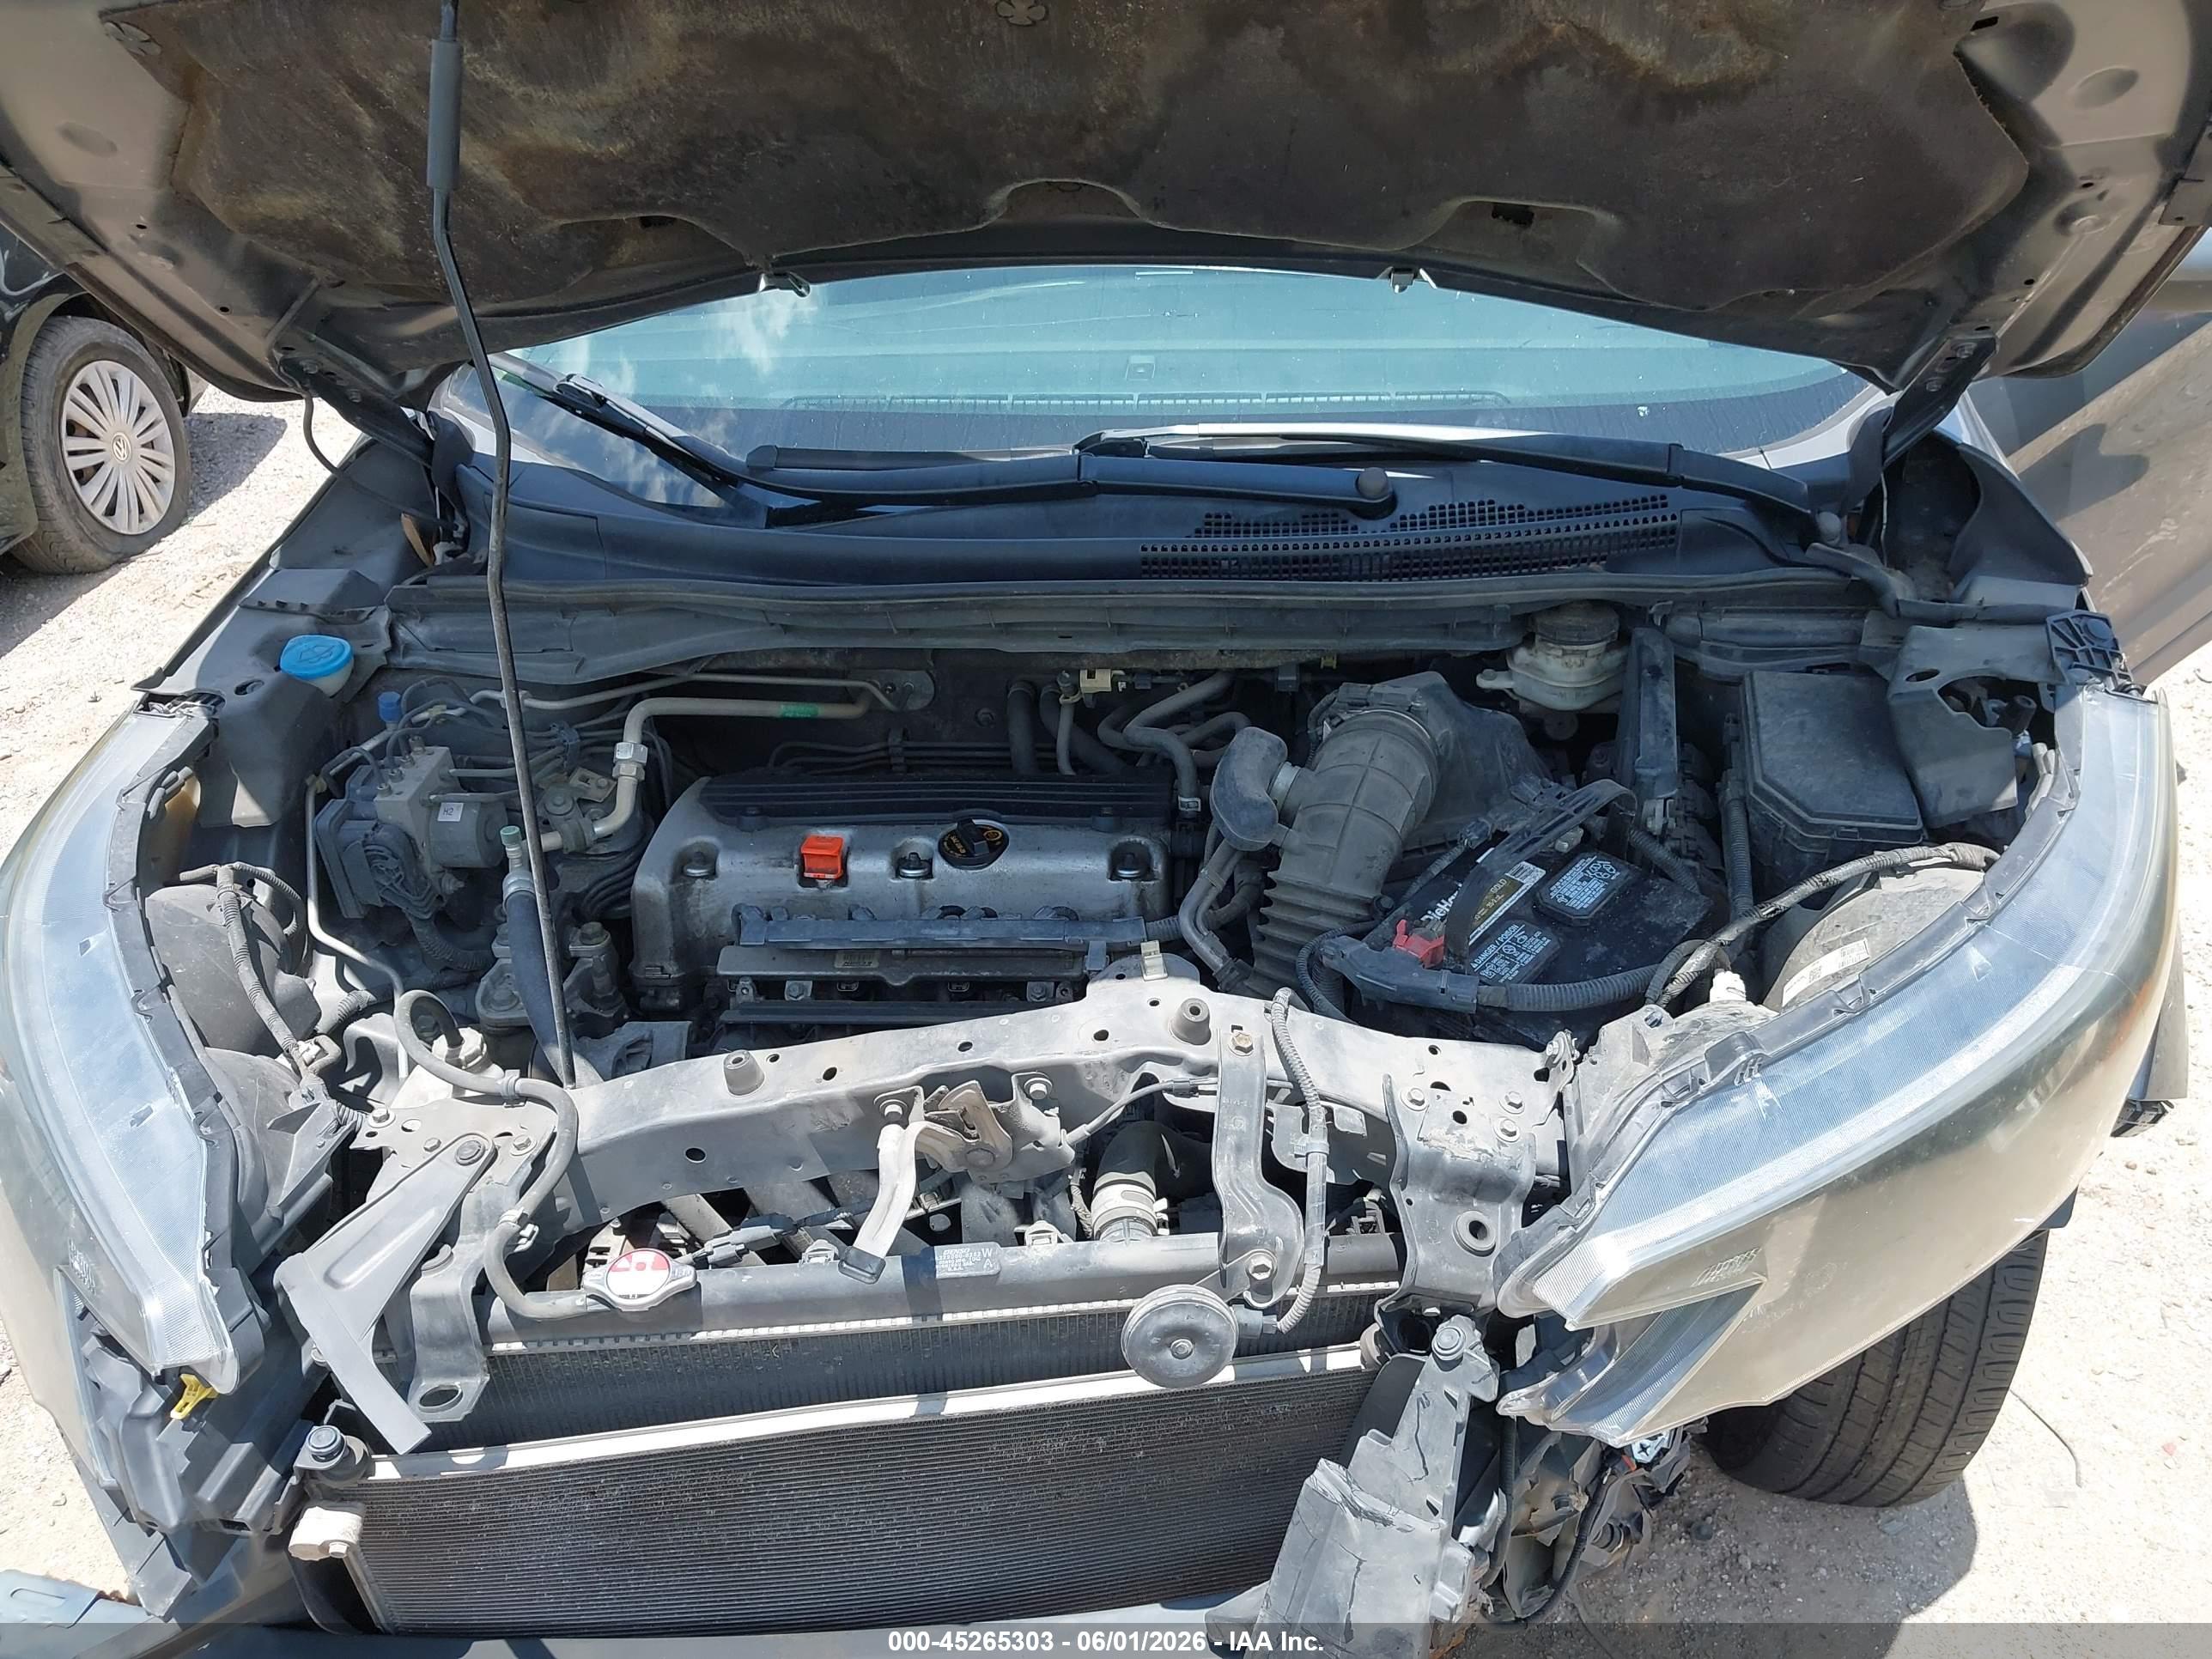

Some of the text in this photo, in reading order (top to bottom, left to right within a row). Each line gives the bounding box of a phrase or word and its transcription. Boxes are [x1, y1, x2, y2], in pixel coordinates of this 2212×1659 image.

[442, 807, 454, 816] H2
[1490, 878, 1508, 893] GOLD
[1474, 944, 1498, 964] DANGER
[1497, 924, 1520, 942] POISON
